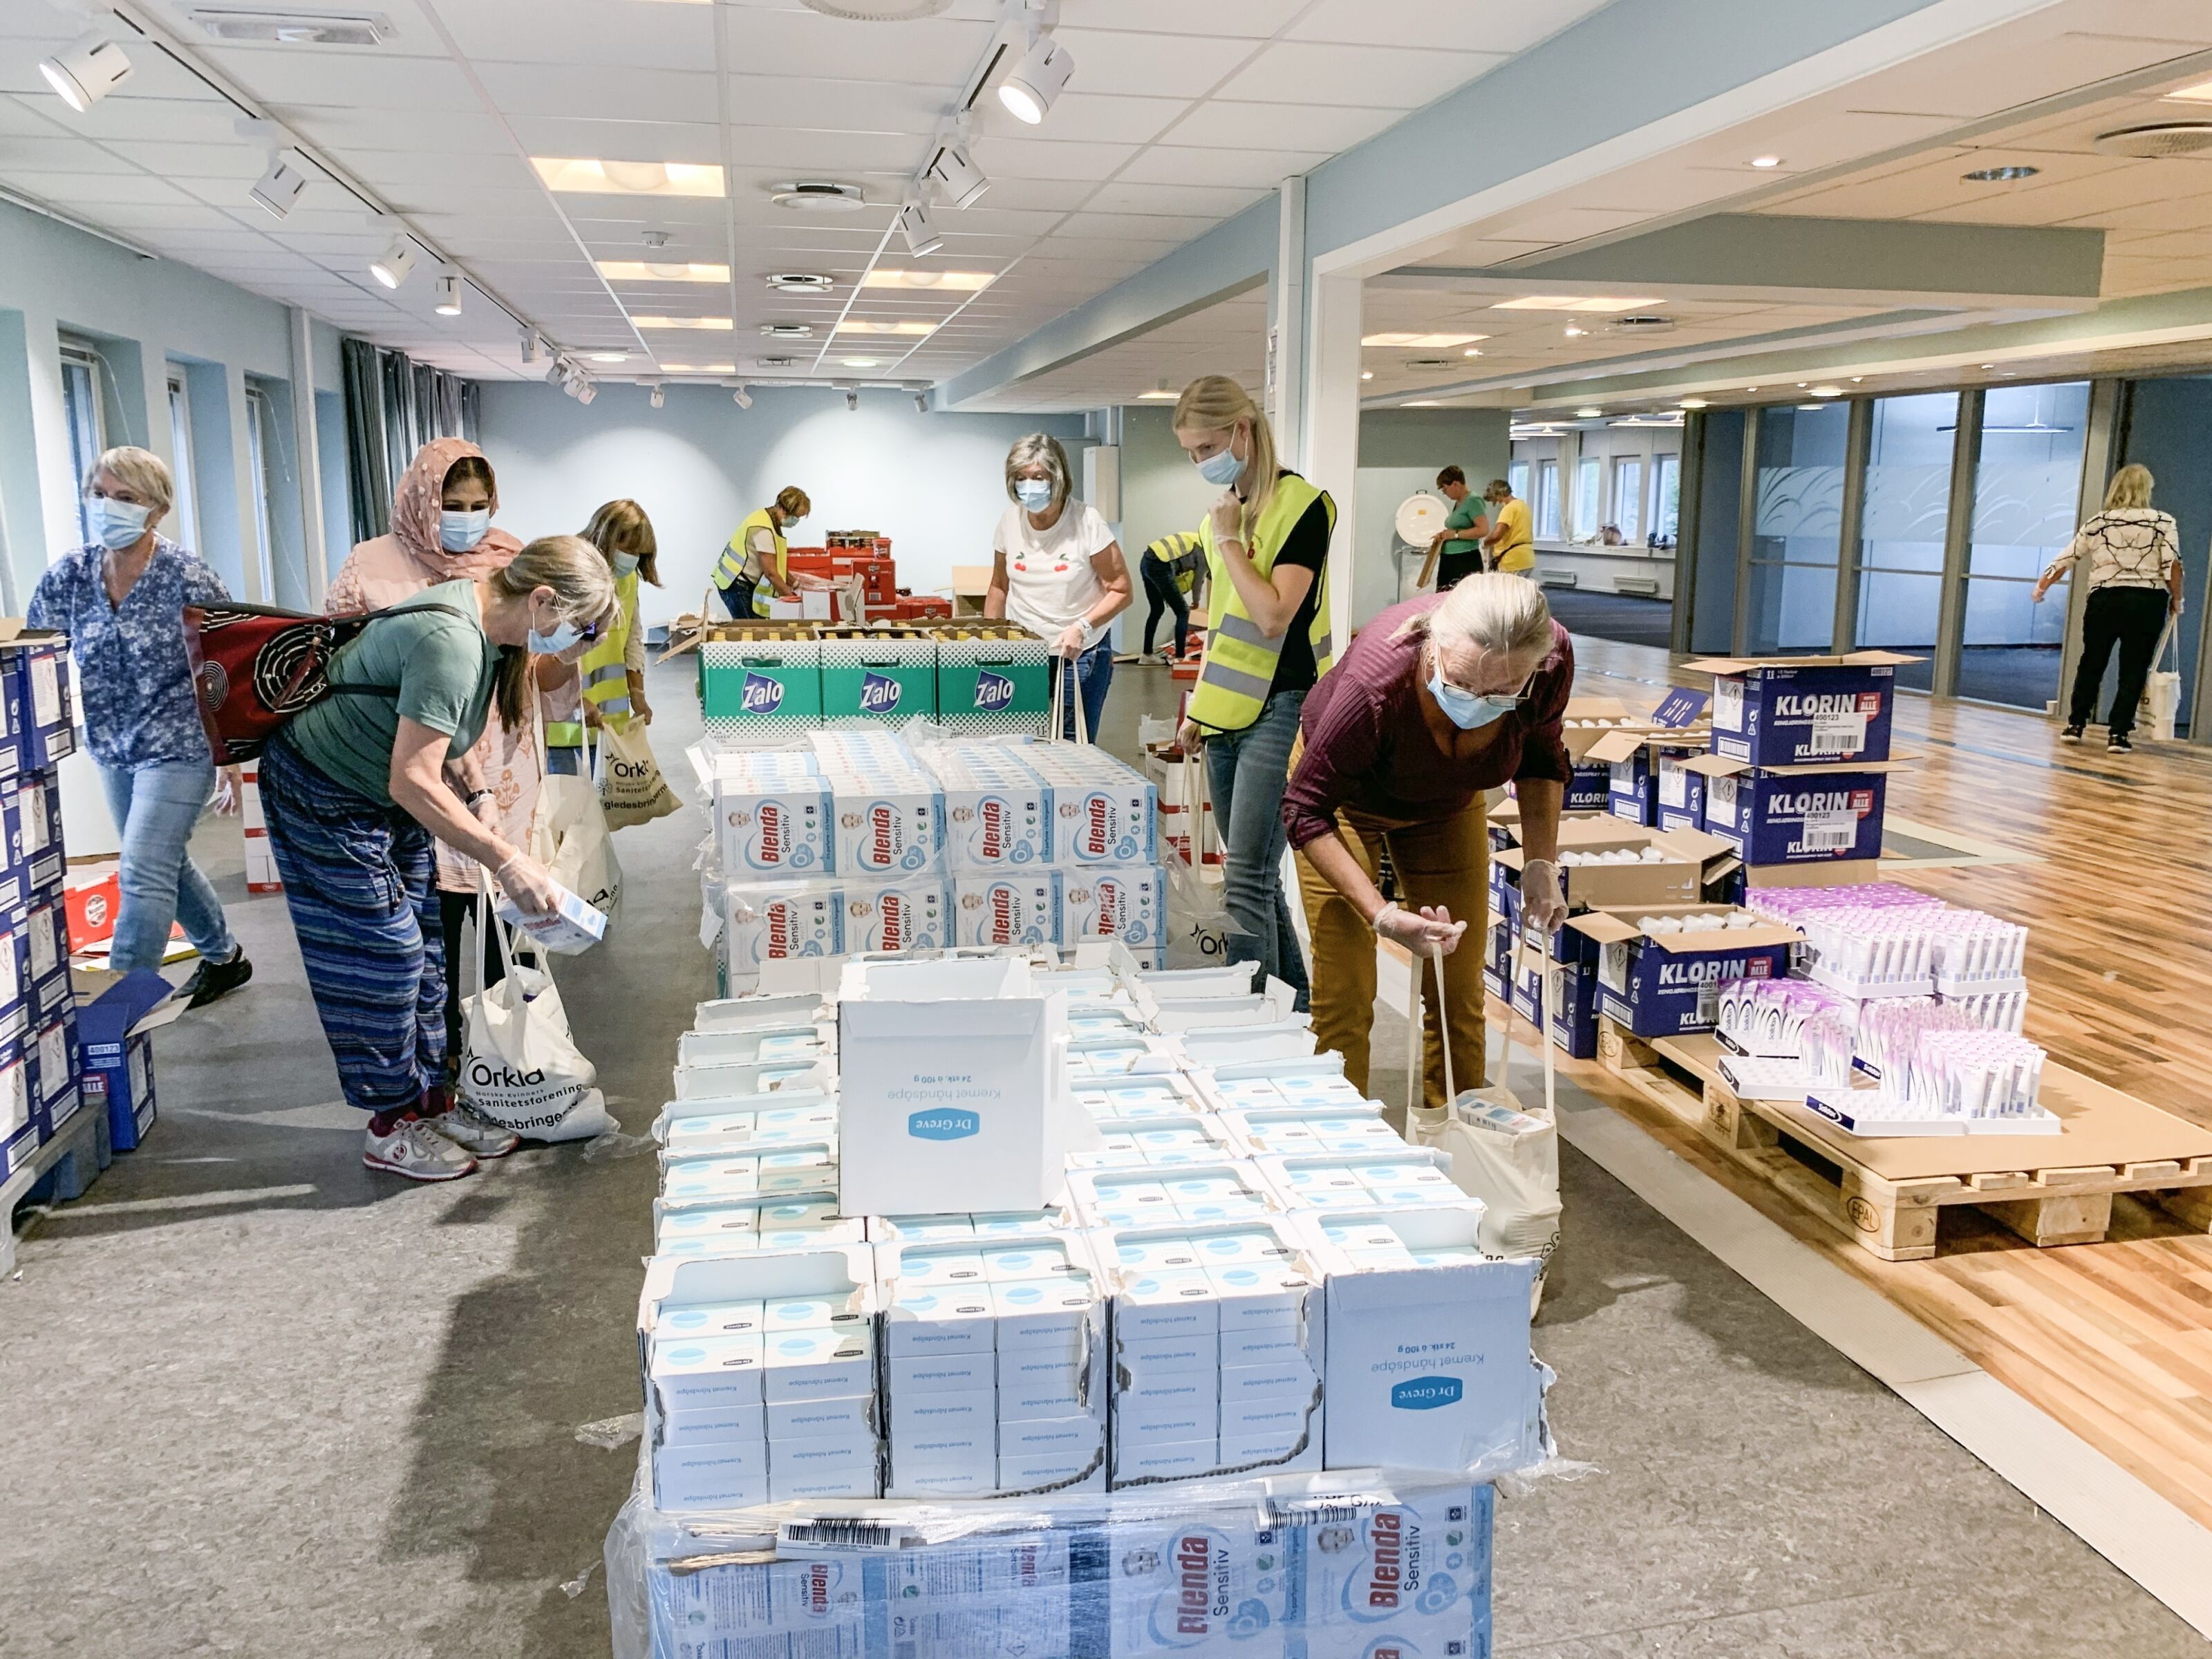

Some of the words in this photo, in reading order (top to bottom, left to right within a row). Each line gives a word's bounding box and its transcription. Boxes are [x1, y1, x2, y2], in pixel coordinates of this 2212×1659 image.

[741, 682, 783, 710] Zalo
[859, 680, 900, 709] Zalo
[974, 680, 1014, 708] Zalo
[1775, 694, 1856, 716] KLORIN
[1860, 701, 1877, 711] ALLE
[604, 783, 667, 809] gledesbrinerne
[1768, 792, 1849, 814] KLORIN
[1852, 798, 1869, 808] ALLE
[762, 807, 779, 862] Blenda
[781, 814, 791, 853] Sensitiv
[873, 809, 891, 864] Blenda
[893, 816, 902, 854] Sensitiv
[983, 803, 1000, 857] Blenda
[1002, 811, 1012, 848] Sensitiv
[1089, 799, 1105, 853] Blenda
[1107, 807, 1117, 844] Sensitiv
[882, 897, 899, 950] Blenda
[902, 904, 911, 942] Sensitiv
[993, 890, 1009, 944] Blenda
[1012, 897, 1021, 935] Sensitiv
[1117, 892, 1126, 929] Sensitiv
[769, 903, 787, 959] Blenda
[789, 911, 798, 950] Sensitiv
[1201, 932, 1228, 955] Ork
[1659, 959, 1745, 984] KLORIN
[1750, 966, 1768, 975] ALLE
[90, 1045, 119, 1053] 400123
[472, 1064, 545, 1087] Orkla
[478, 1084, 582, 1107] Sanitetsforening
[507, 1089, 543, 1098] Kvinners
[888, 1089, 952, 1102] håndsåpe
[955, 1089, 1000, 1099] Kremet
[491, 1100, 578, 1130] esbringe
[916, 1119, 953, 1130] Greve
[955, 1119, 971, 1129] Dr
[1853, 1201, 1875, 1228] EPAL
[1371, 1358, 1436, 1373] håndsåpe
[1440, 1354, 1483, 1367] Kremet
[1399, 1387, 1436, 1398] Greve
[1438, 1386, 1454, 1396] Dr
[1369, 1514, 1400, 1607] Blenda
[1404, 1526, 1420, 1591] Sensitiv
[800, 1574, 809, 1606] Sensitiv
[812, 1564, 828, 1613] Blenda
[1177, 1537, 1208, 1633] Blenda
[1213, 1550, 1229, 1615] Sensitiv
